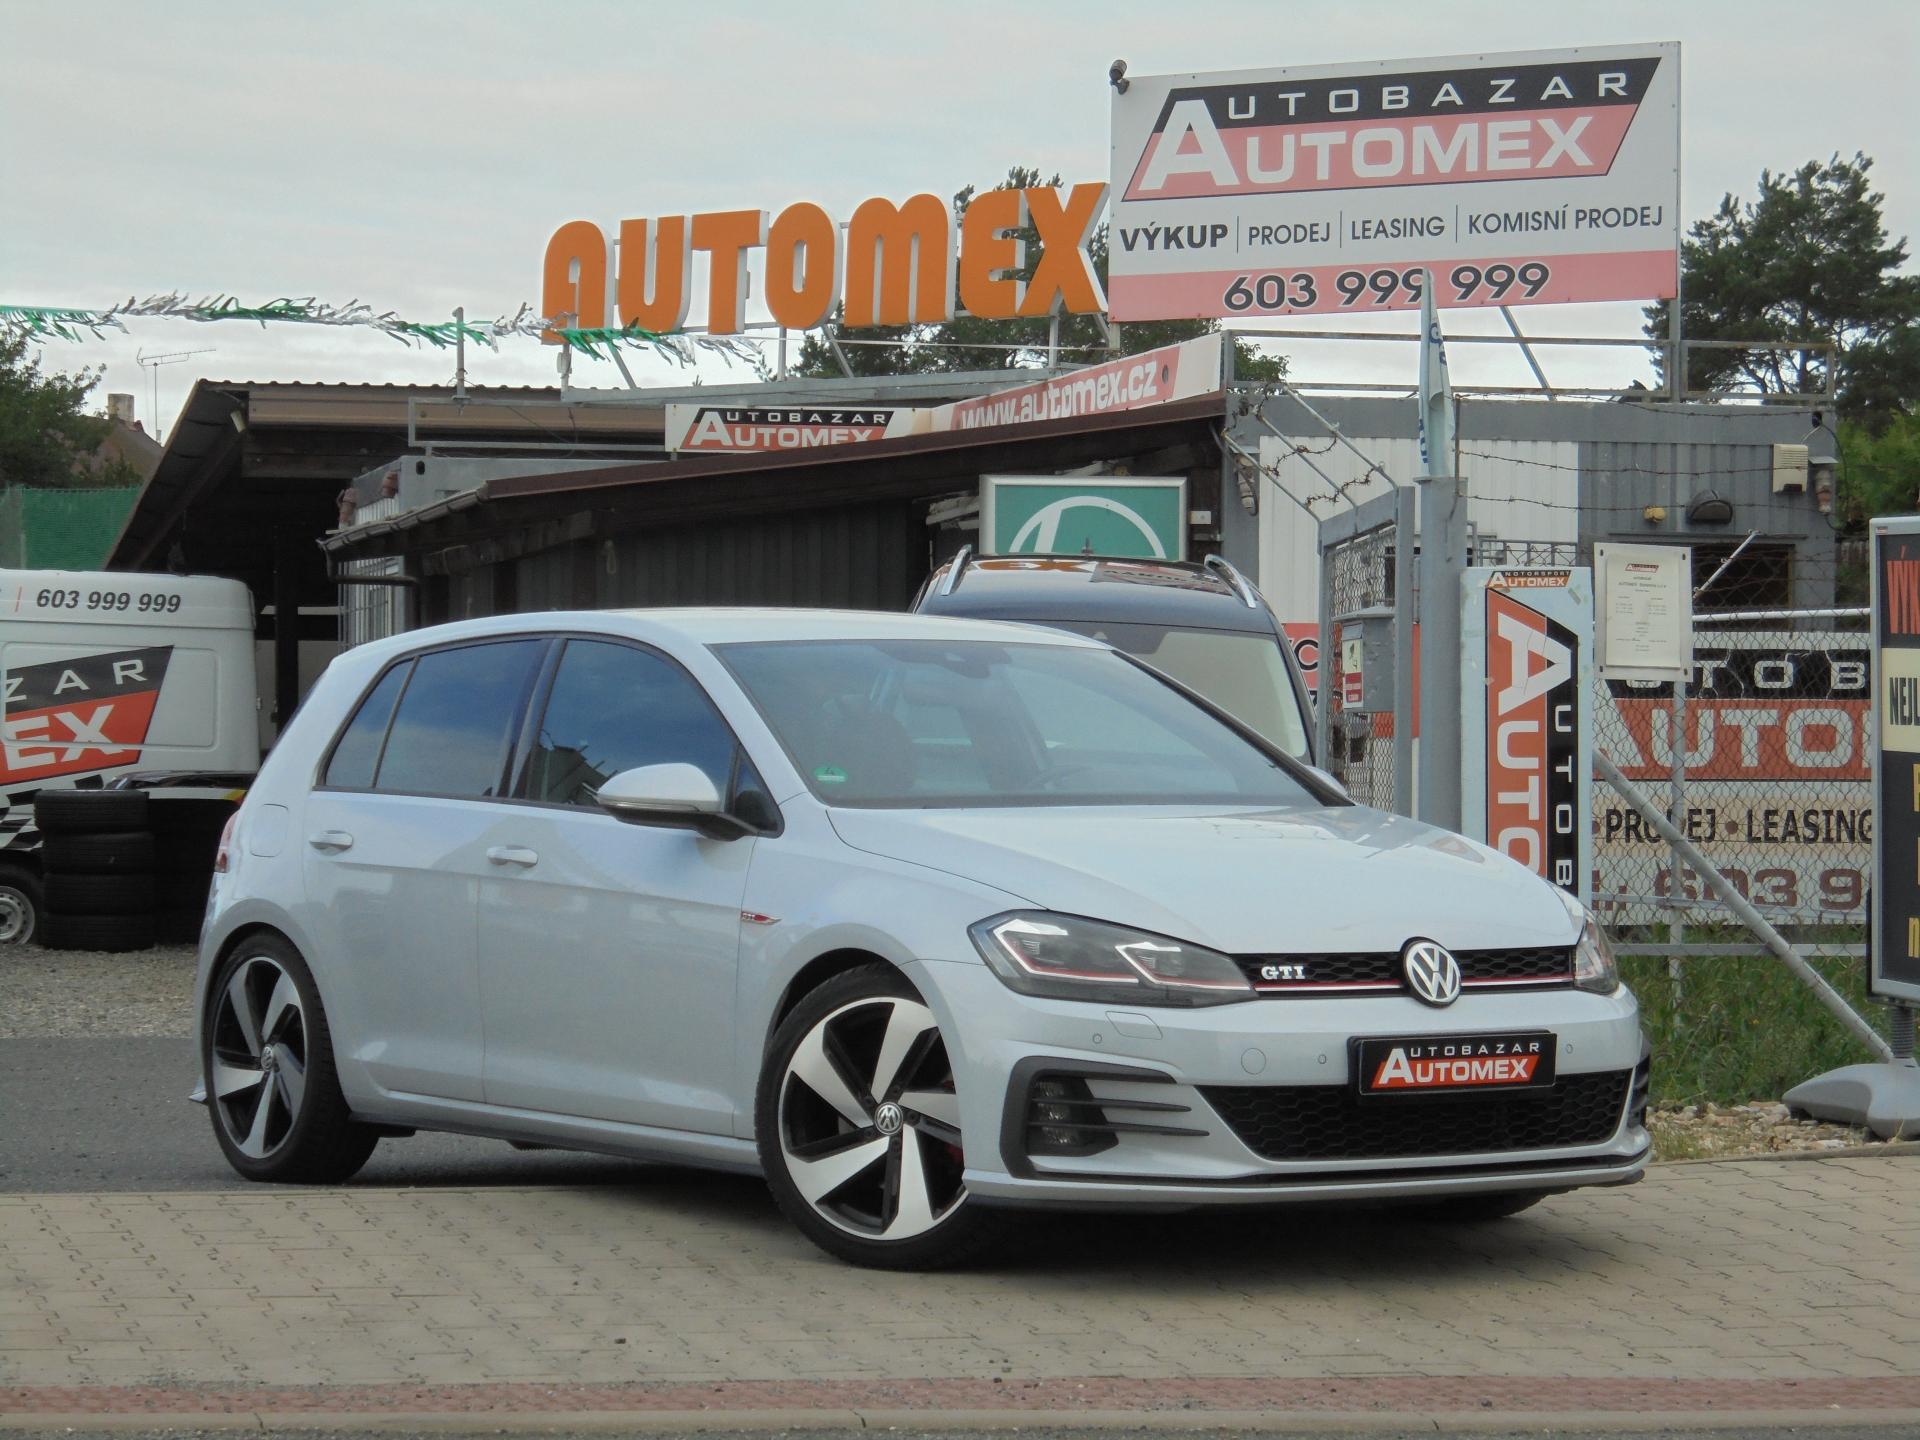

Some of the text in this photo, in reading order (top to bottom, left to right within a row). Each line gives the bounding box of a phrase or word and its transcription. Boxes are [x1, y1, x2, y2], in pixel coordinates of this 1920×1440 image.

[1138, 99, 1595, 191] AUTOMEX
[1119, 221, 1229, 253] VÝKUP
[1248, 222, 1331, 246] PRODEJ
[1351, 216, 1446, 241] LEASING
[1468, 203, 1663, 235] KOMISNÍ PRODEJ
[542, 182, 1110, 345] AUTOMEX
[1225, 262, 1550, 310] 603 999 999
[962, 361, 1157, 429] www.automex.cz
[689, 411, 873, 448] AUTOMEX
[1488, 571, 1565, 587] AUTOMEX
[36, 588, 182, 613] 603 999 999
[5, 659, 148, 703] ZAR
[1626, 660, 1865, 689] TOB
[3, 704, 125, 770] EX
[1497, 611, 1572, 875] AUTO
[1747, 809, 1871, 844] LEASING
[1261, 965, 1306, 980] GTI
[1378, 1048, 1529, 1085] AUTOMEX
